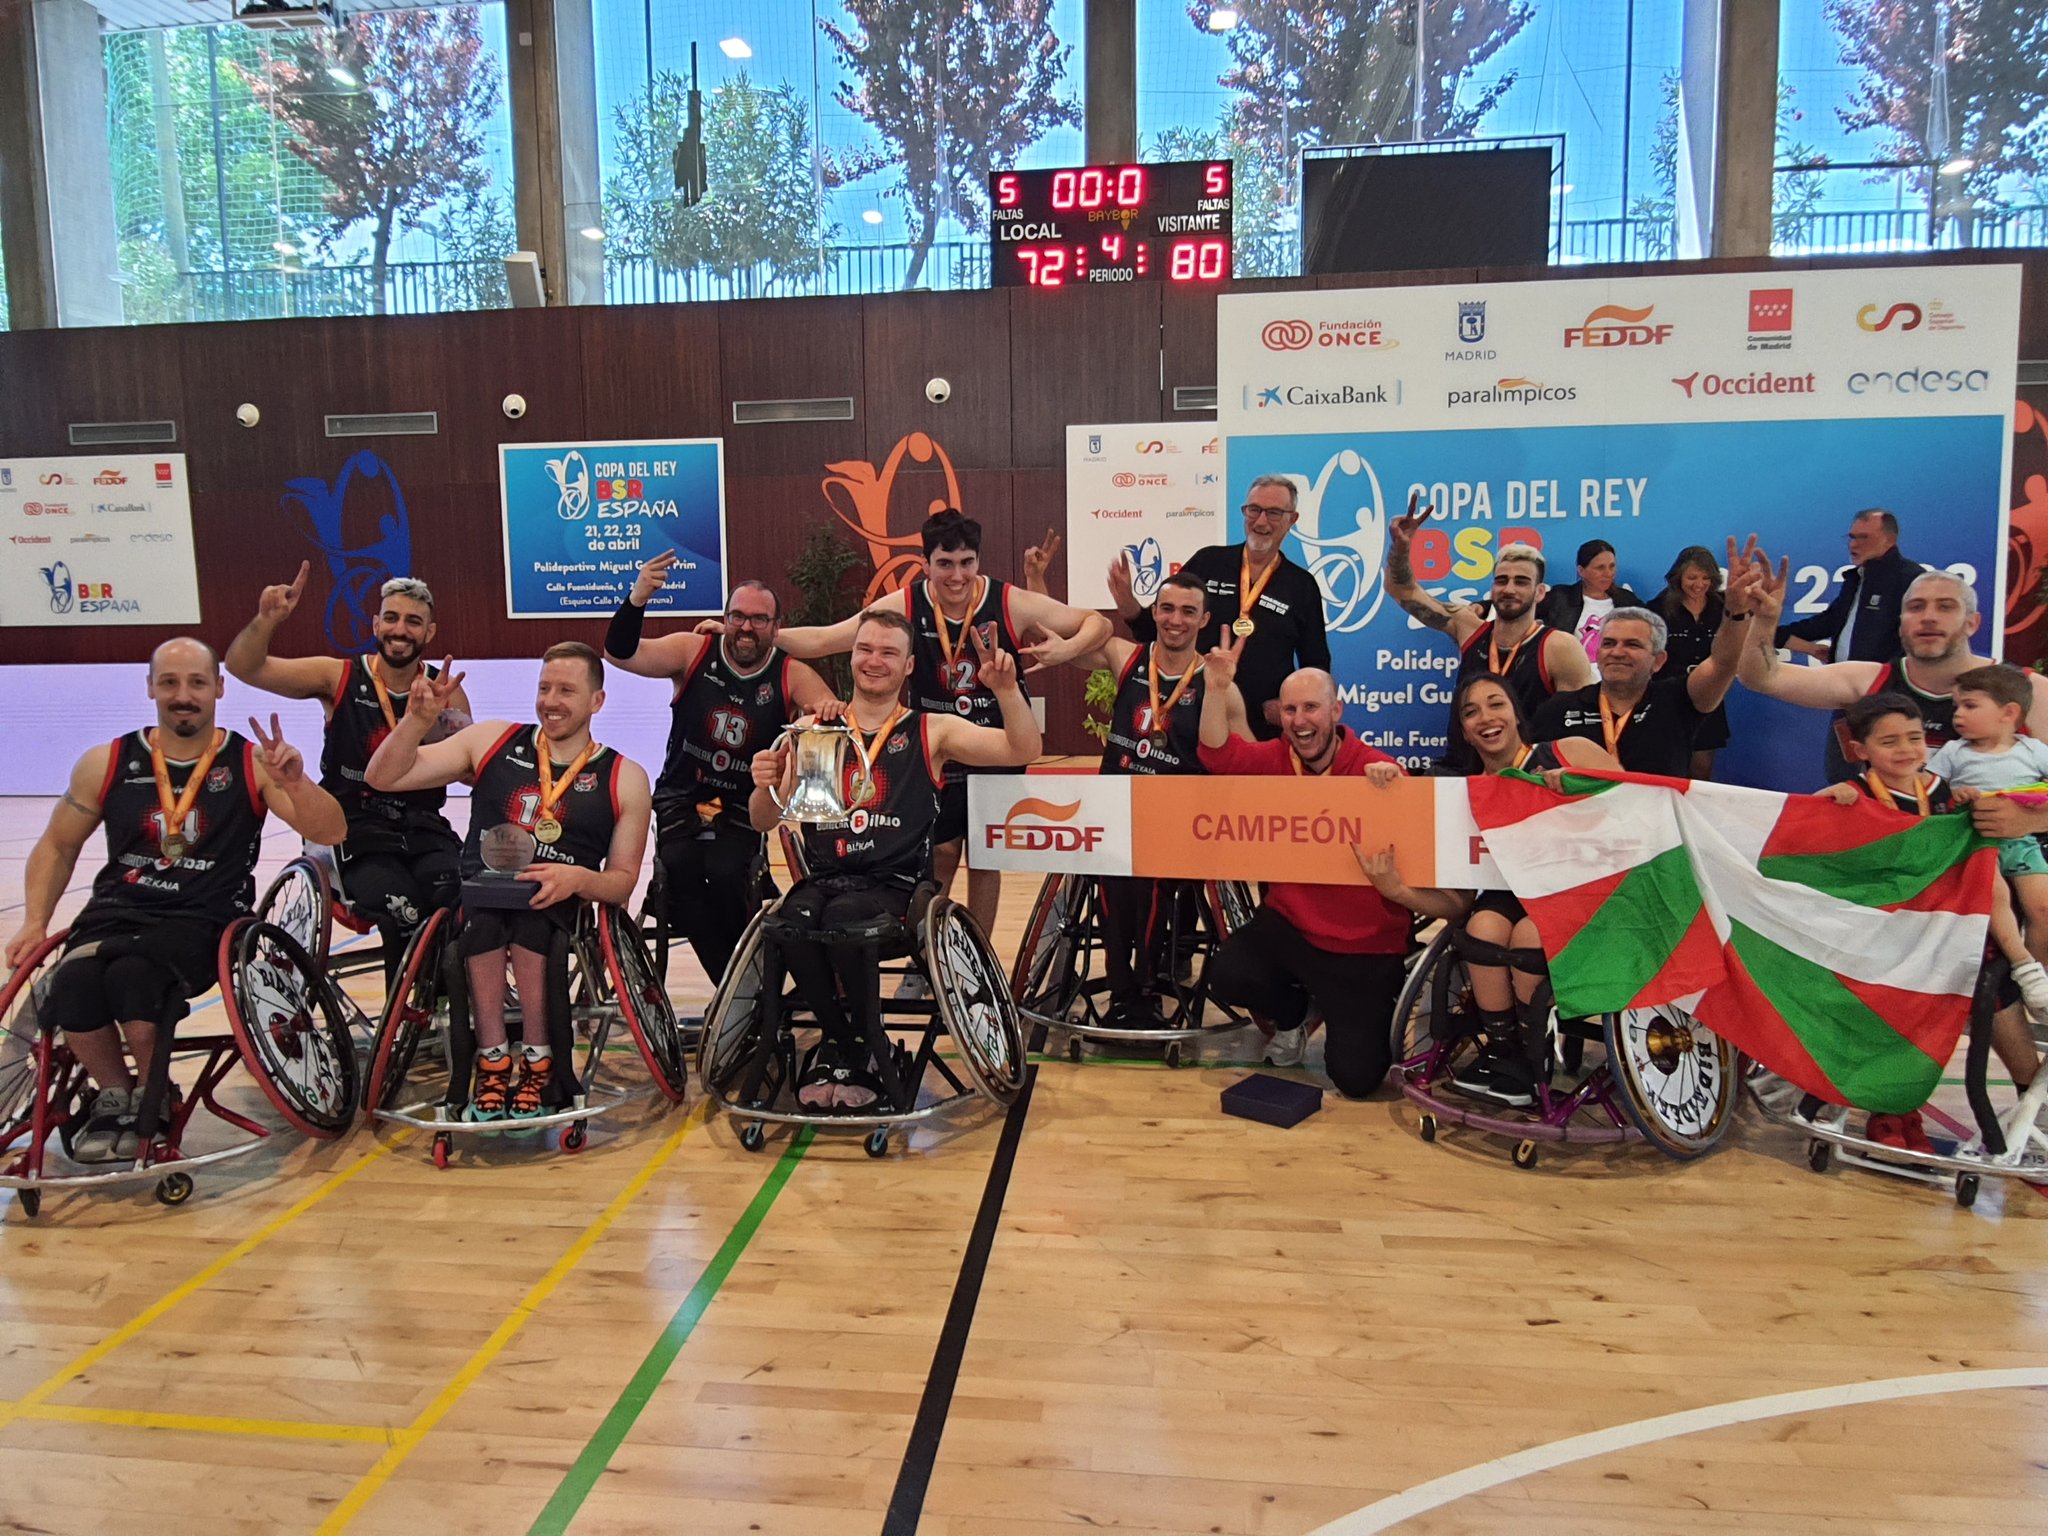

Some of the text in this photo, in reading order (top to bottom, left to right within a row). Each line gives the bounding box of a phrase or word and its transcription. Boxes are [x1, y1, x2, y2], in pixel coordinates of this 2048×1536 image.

[1206, 167, 1223, 194] 5
[999, 177, 1016, 204] 5
[1197, 198, 1230, 211] FALTAS
[992, 208, 1024, 221] FALTAS
[1158, 214, 1221, 233] VISITANTE
[1000, 222, 1062, 241] LOCAL
[1102, 236, 1119, 260] 4
[1017, 250, 1065, 286] 72
[1171, 243, 1223, 280] 80
[1089, 267, 1134, 283] PERIODO
[1318, 319, 1383, 331] Fundación
[1317, 331, 1383, 348] ONCE
[1563, 324, 1674, 349] FEDDF
[1444, 348, 1497, 362] MADRID
[1702, 371, 1816, 395] Occident
[1848, 366, 1988, 395] endesa
[1286, 384, 1387, 406] CaixaBank
[595, 460, 677, 478] COPA DEL REY
[595, 479, 644, 500] BSR
[1138, 478, 1168, 486] ONCE
[1408, 477, 1648, 521] COPA DEL REY
[597, 500, 679, 518] ESPAÑA
[1101, 509, 1143, 519] Occident
[584, 524, 642, 538] 21, 22, 23
[588, 538, 640, 551] de abril
[534, 562, 596, 576] Polideportivo
[600, 560, 633, 574] Miguel
[77, 583, 113, 599] BSR
[546, 582, 566, 592] Calle
[80, 600, 140, 613] ESPAÑA
[1376, 648, 1460, 678] Polidep
[1336, 683, 1453, 712] Miguel Gu
[713, 711, 748, 748] 13
[1360, 731, 1404, 747] Calle
[1192, 808, 1363, 845] CAMPEÓN
[985, 824, 1105, 853] FEDDF
